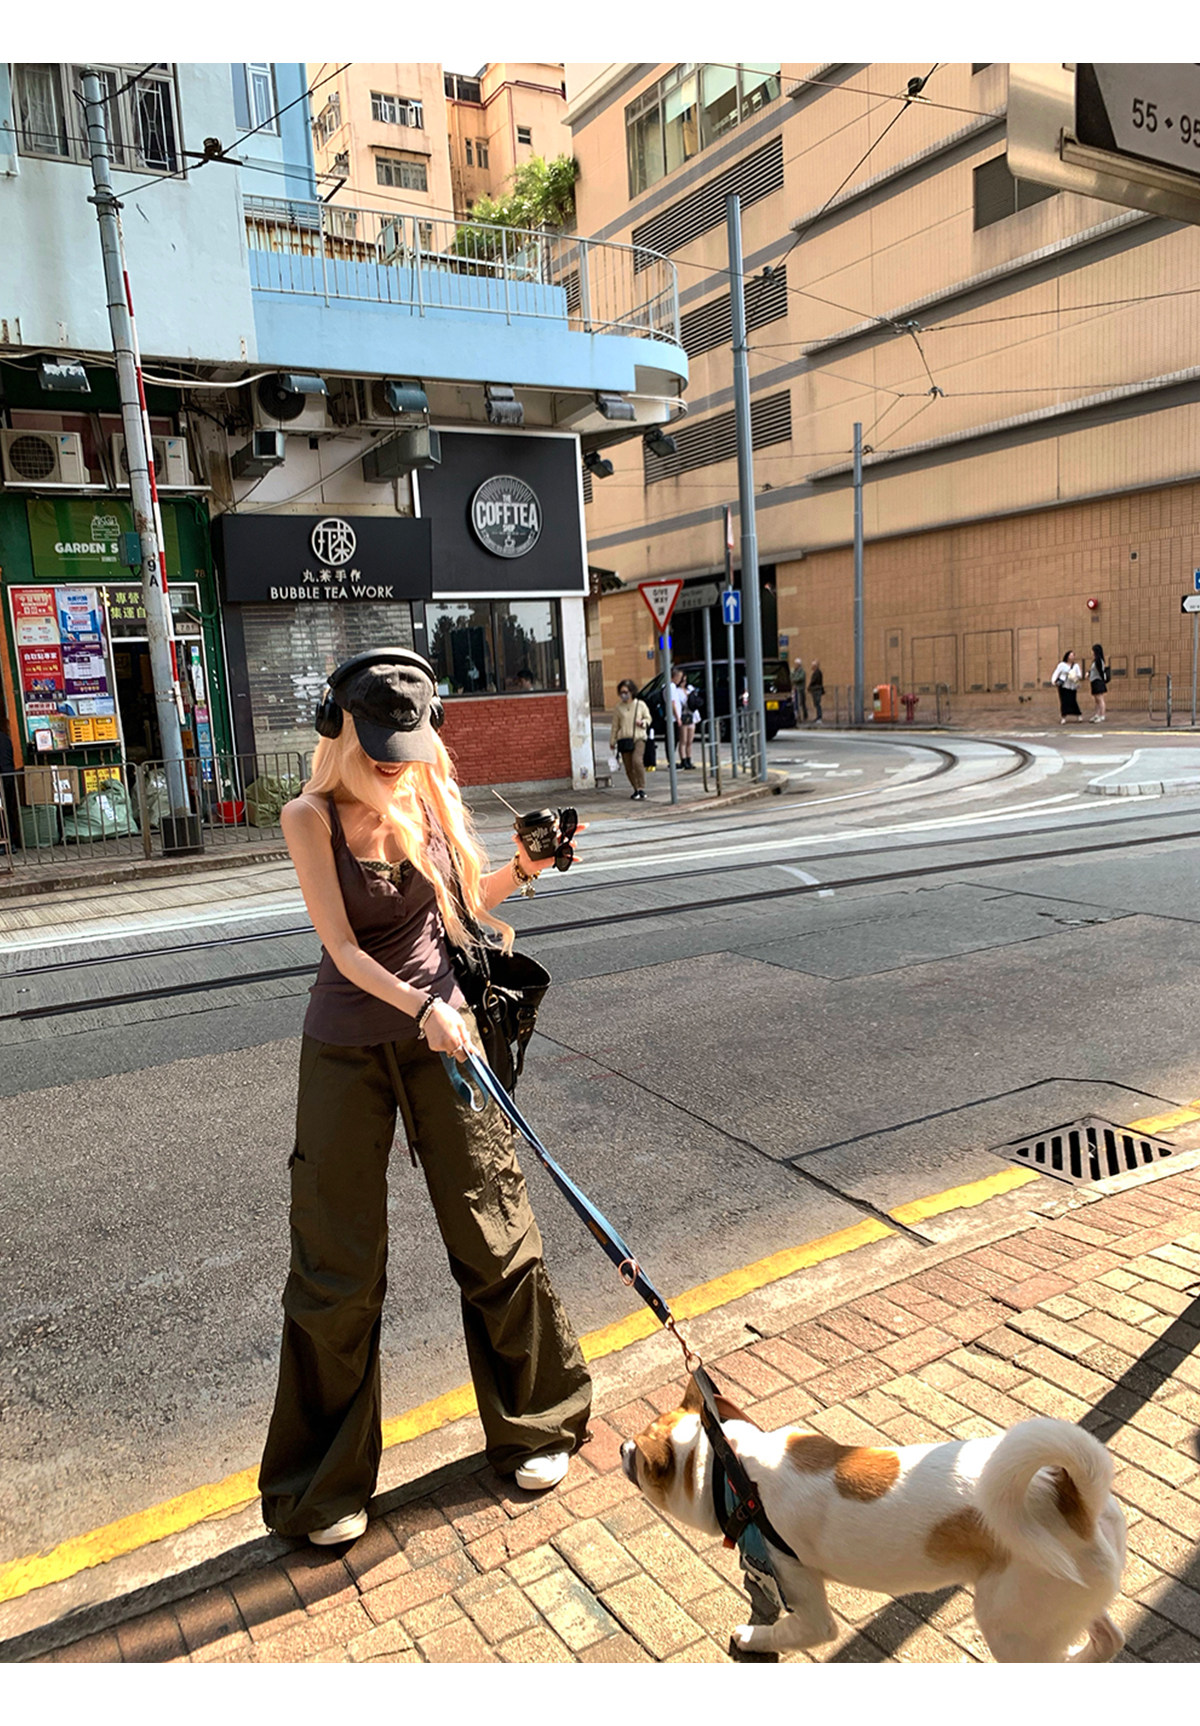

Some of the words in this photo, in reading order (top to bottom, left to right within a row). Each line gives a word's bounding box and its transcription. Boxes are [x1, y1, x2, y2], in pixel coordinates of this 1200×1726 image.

[1132, 97, 1158, 133] 55
[476, 501, 539, 532] COFFTEA
[54, 542, 107, 554] GARDEN
[147, 560, 157, 572] 9
[149, 574, 159, 587] A
[115, 591, 145, 604] 專營
[270, 586, 319, 600] BUBBLE
[324, 586, 348, 599] TEA
[351, 585, 394, 598] WORK
[653, 588, 668, 597] GIVE
